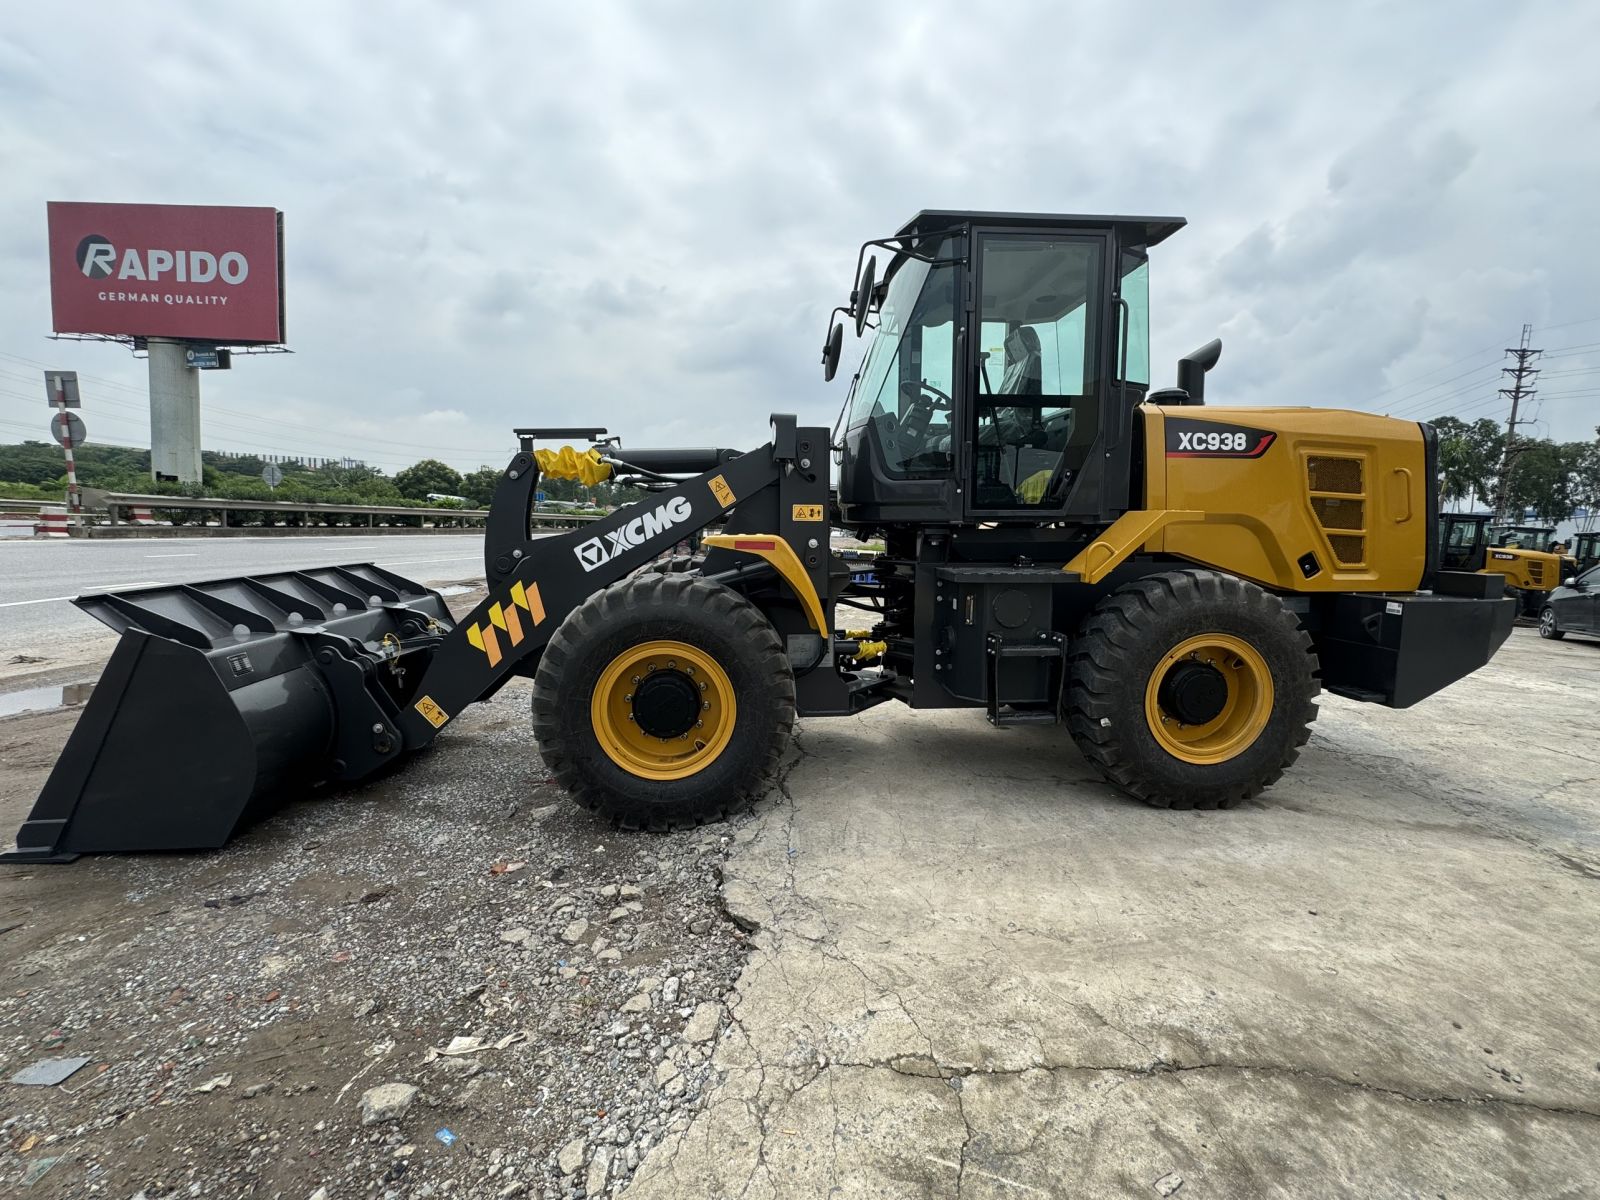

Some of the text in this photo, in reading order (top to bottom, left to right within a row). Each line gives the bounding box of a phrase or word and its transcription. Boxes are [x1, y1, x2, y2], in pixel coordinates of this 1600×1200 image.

[82, 243, 249, 285] RAPIDO
[98, 292, 228, 305] GERMAN QUALITY
[1178, 432, 1247, 451] XC938
[604, 496, 692, 559] XCMG
